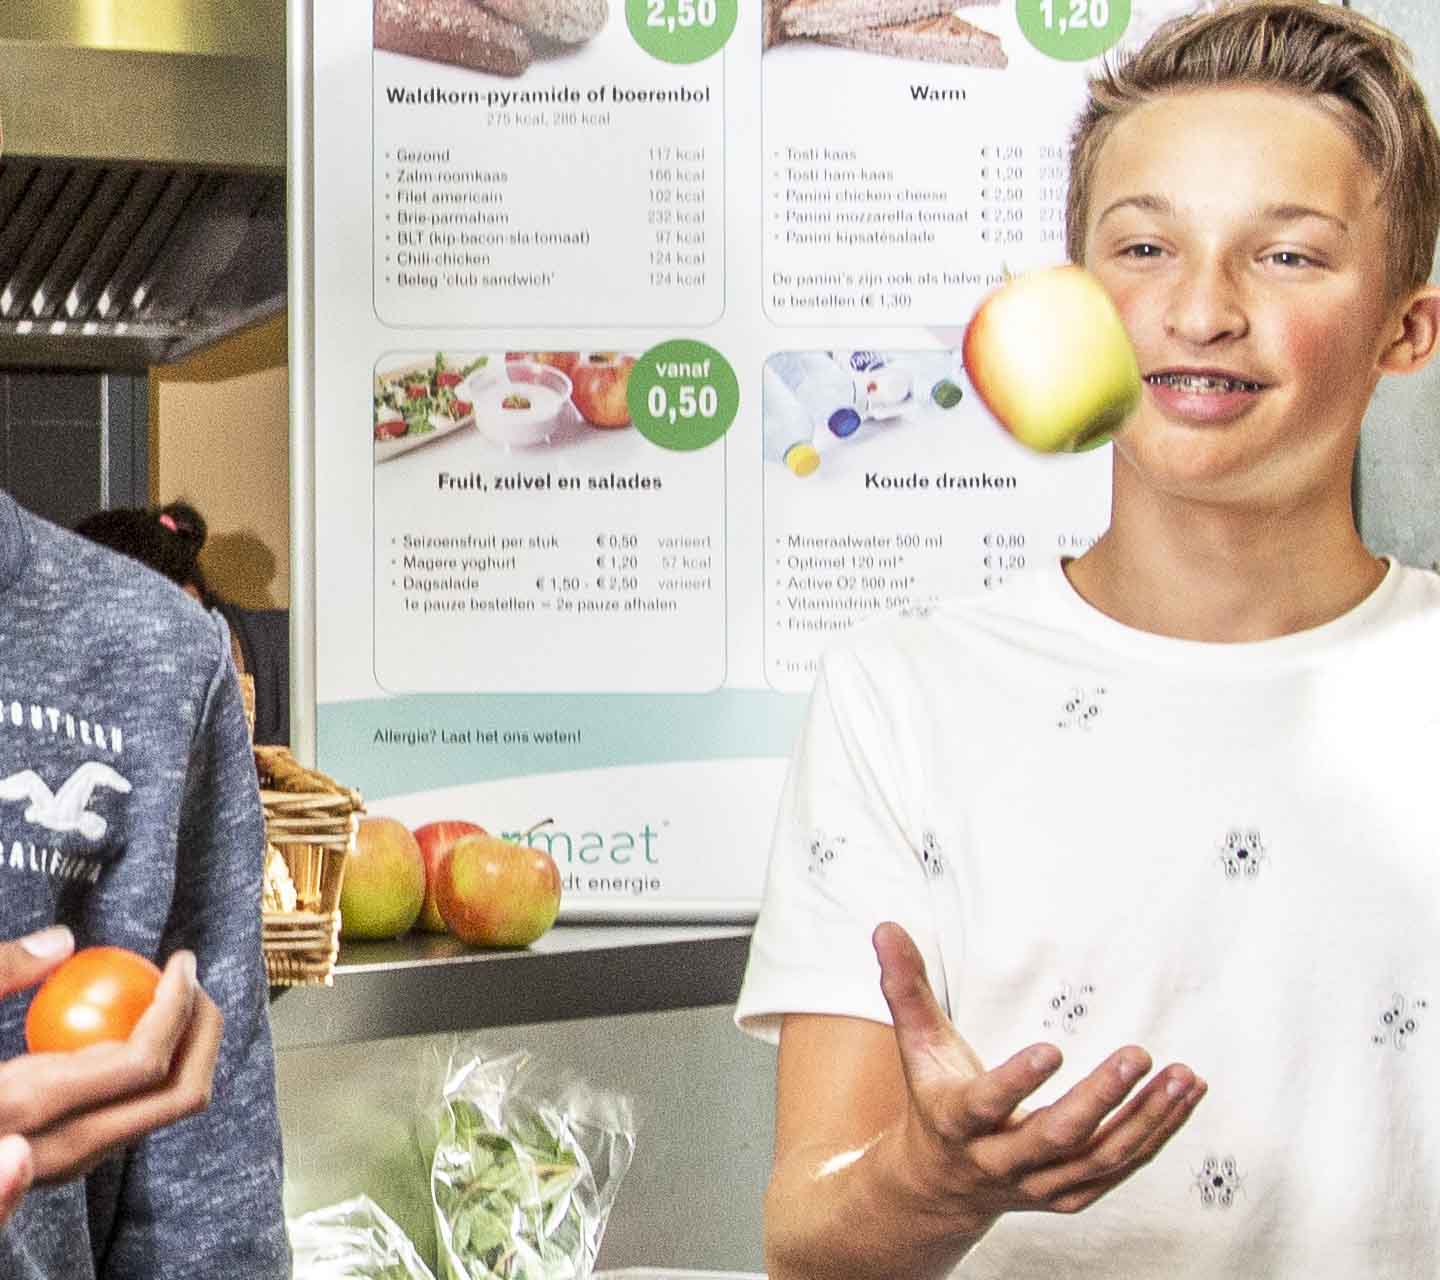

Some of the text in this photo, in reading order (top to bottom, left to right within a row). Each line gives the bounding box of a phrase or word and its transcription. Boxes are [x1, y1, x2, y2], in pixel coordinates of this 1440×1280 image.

[386, 85, 709, 107] Waldkorn-pyramide of boerenbol
[910, 85, 966, 101] Warm
[397, 149, 449, 163] Gezond
[676, 147, 704, 160] kcal
[788, 148, 818, 160] Tosti
[824, 148, 856, 160] kaas
[997, 146, 1022, 160] 1,20
[676, 168, 704, 183] kcal
[787, 168, 818, 182] Tosti
[997, 167, 1023, 182] 1,20
[398, 189, 426, 204] Filet
[432, 192, 502, 204] americain
[676, 187, 704, 203] kcal
[787, 189, 830, 203] Panini
[995, 187, 1023, 202] 2,50
[674, 209, 704, 224] kcal
[785, 208, 831, 224] Panini
[995, 209, 1023, 222] 2,50
[398, 230, 424, 245] BLT
[677, 231, 704, 244] kcal
[787, 231, 830, 244] Panini
[995, 229, 1023, 244] 2,50
[677, 251, 704, 264] kcal
[398, 272, 437, 288] Beleg
[677, 272, 704, 288] kcal
[773, 272, 792, 286] De
[888, 272, 912, 284] ook
[918, 272, 938, 285] als
[943, 272, 981, 284] halve
[773, 296, 785, 307] te
[791, 294, 855, 307] bestellen
[656, 361, 710, 377] vanaf
[647, 386, 717, 424] 0,50
[439, 472, 662, 493] Fruit, zuivel en salades
[865, 472, 1016, 488] Koude dranken
[403, 534, 495, 549] Seizoensfruit
[502, 538, 522, 551] per
[529, 536, 558, 549] stuk
[610, 535, 637, 549] 0,50
[788, 535, 890, 548] Mineraalwater
[896, 536, 920, 547] 500
[925, 534, 942, 548] ml
[996, 535, 1024, 548] 0,80
[404, 554, 456, 571] Magere
[461, 556, 515, 572] yoghurt
[612, 555, 637, 571] 1,20
[683, 555, 711, 568] kcal
[788, 556, 844, 571] Optimel
[852, 556, 874, 568] 120
[999, 555, 1025, 570] 1,20
[404, 576, 479, 592] Dagsalade
[551, 576, 580, 592] 1,50
[610, 576, 637, 592] 2,50
[788, 576, 832, 592] Active
[862, 576, 885, 592] 500
[405, 597, 676, 614] 1e pauze bestellen 2e pauze afhalen
[787, 596, 880, 610] Vitamindrink
[373, 728, 581, 746] Allergie? Laat het ons weten!
[588, 877, 660, 895] energie
